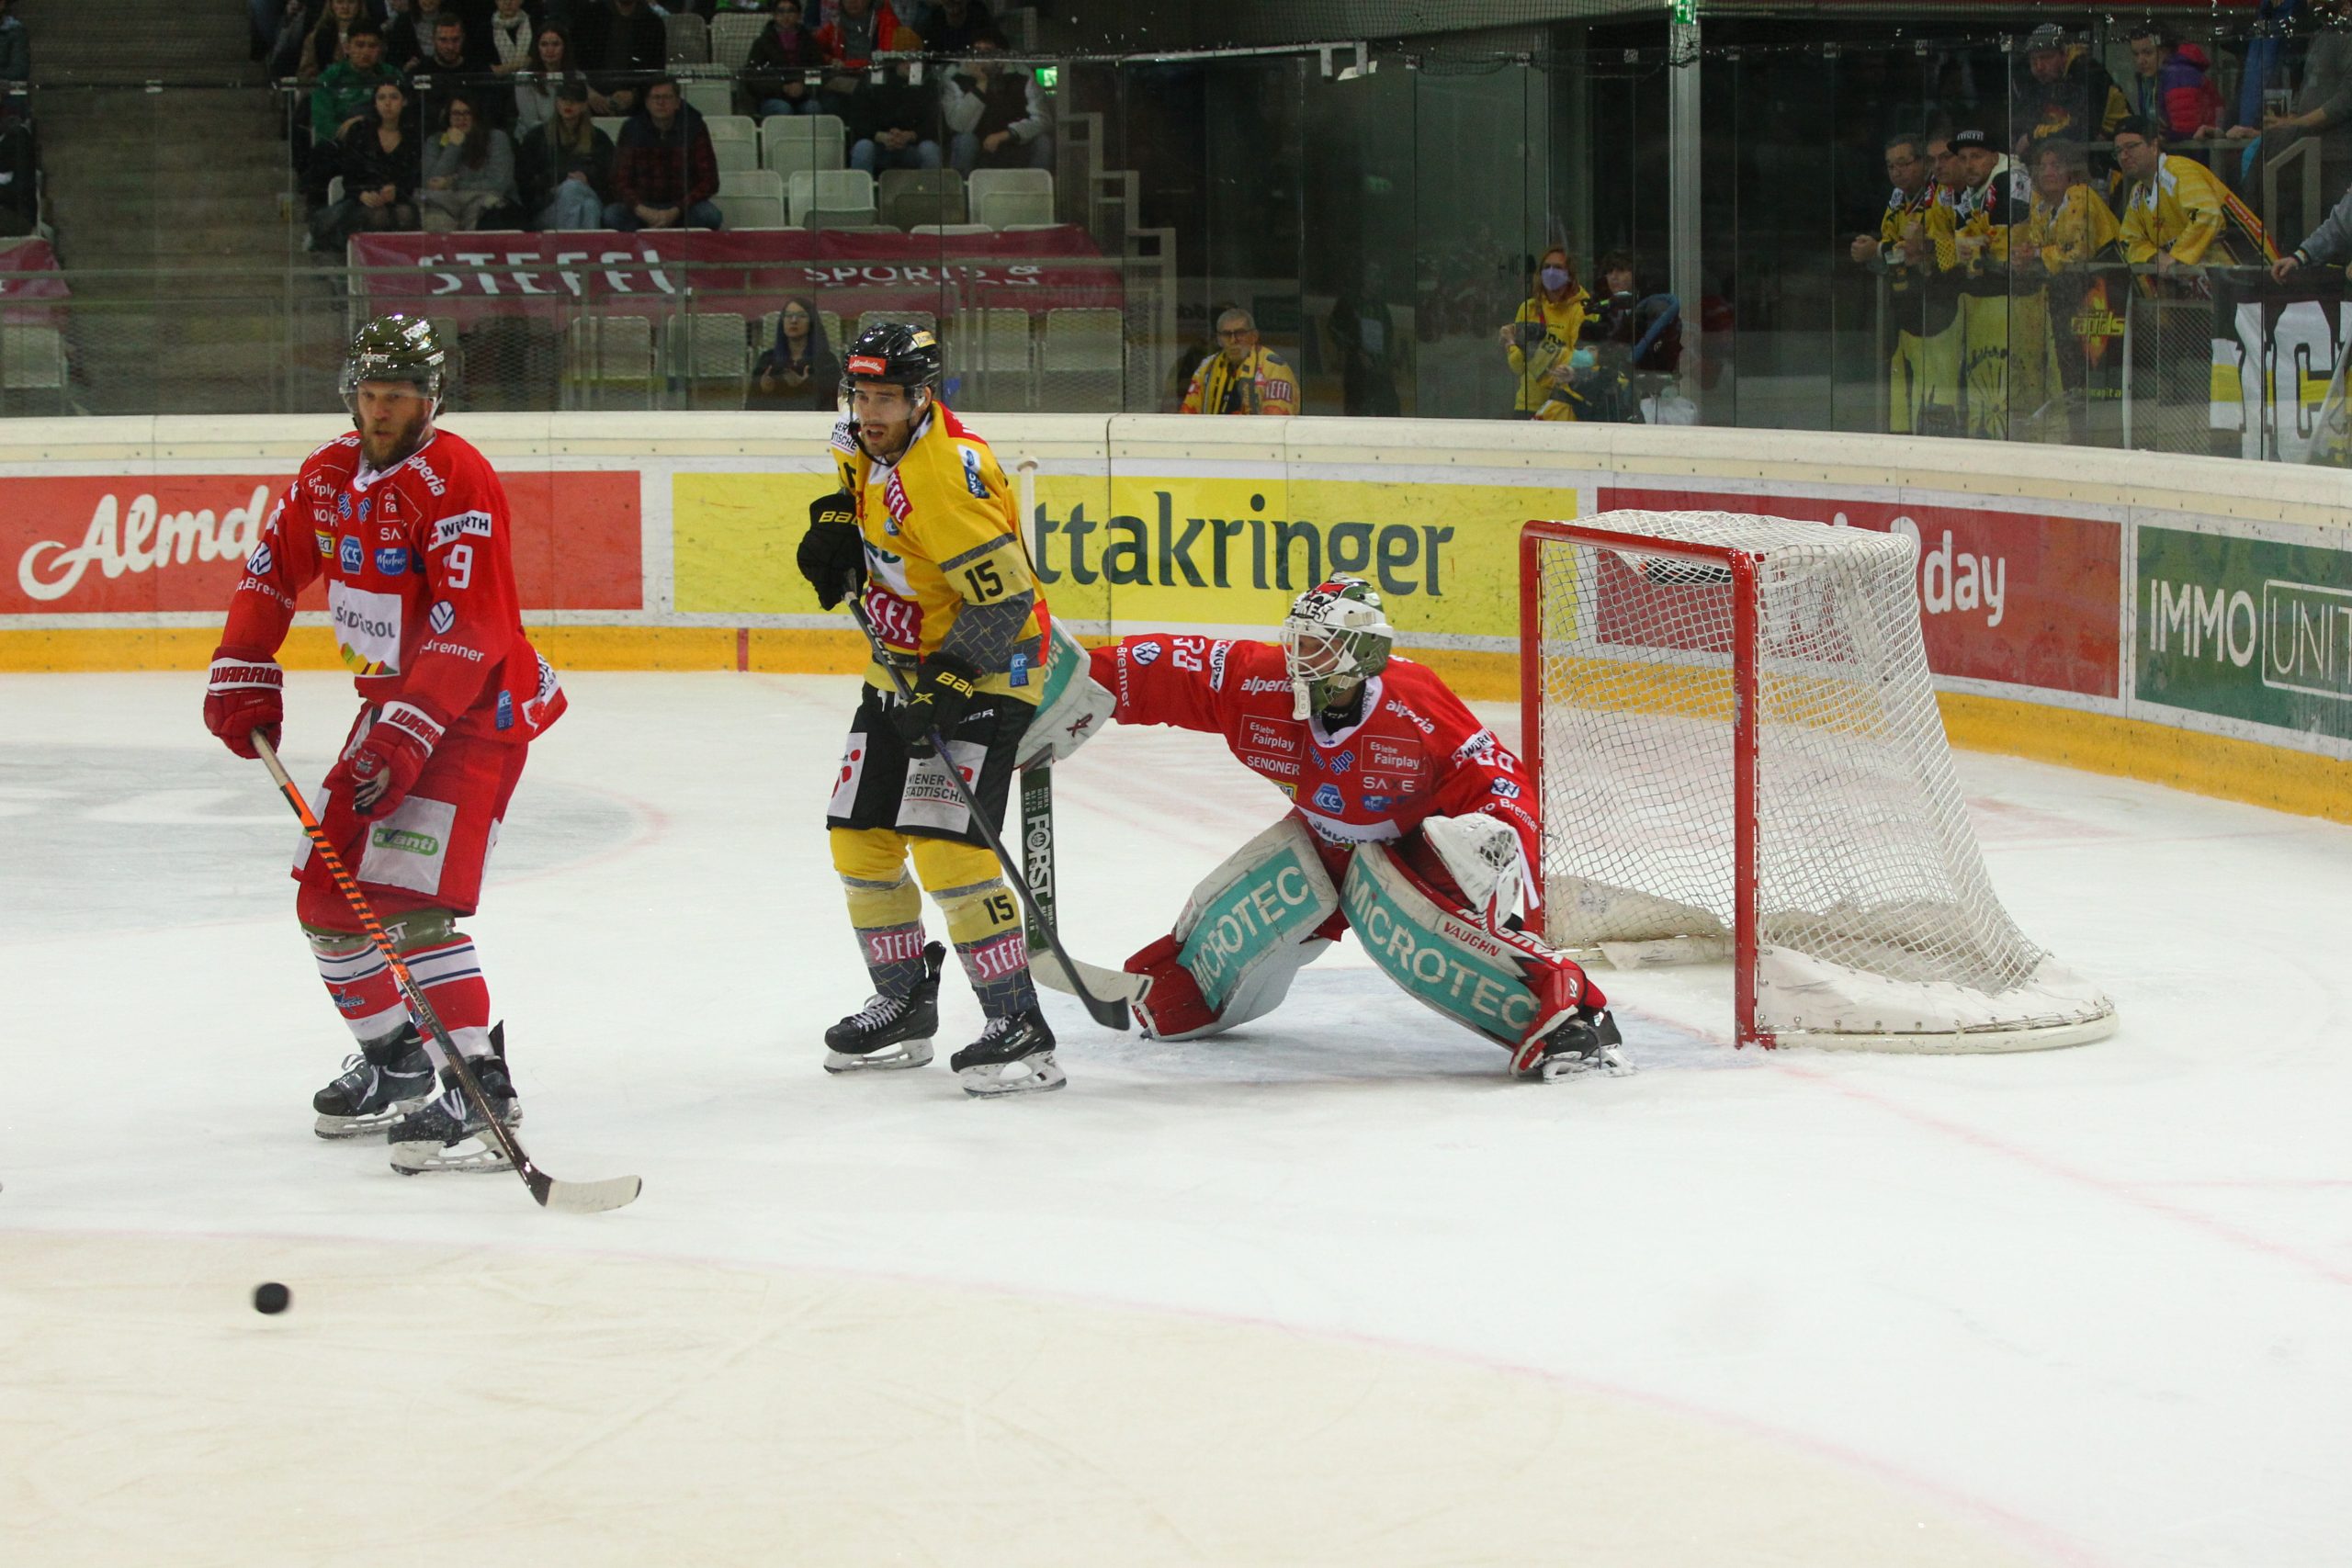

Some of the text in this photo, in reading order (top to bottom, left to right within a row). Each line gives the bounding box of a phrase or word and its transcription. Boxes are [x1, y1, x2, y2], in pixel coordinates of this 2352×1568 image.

[18, 484, 276, 601] Almd
[965, 559, 1004, 603] 15
[2150, 579, 2256, 668] IMMO
[867, 624, 897, 665] CCM
[1116, 647, 1130, 707] Brenner
[1240, 676, 1295, 696] alperia
[1252, 733, 1295, 751] Fairplay
[1247, 755, 1300, 775] SENONER
[1330, 750, 1355, 774] alpo
[1374, 752, 1420, 771] Fairplay
[1316, 793, 1340, 808] ICE
[374, 829, 435, 852] avanti
[1026, 813, 1052, 898] FORST
[983, 895, 1014, 925] 15
[1444, 921, 1501, 958] VAUGHN
